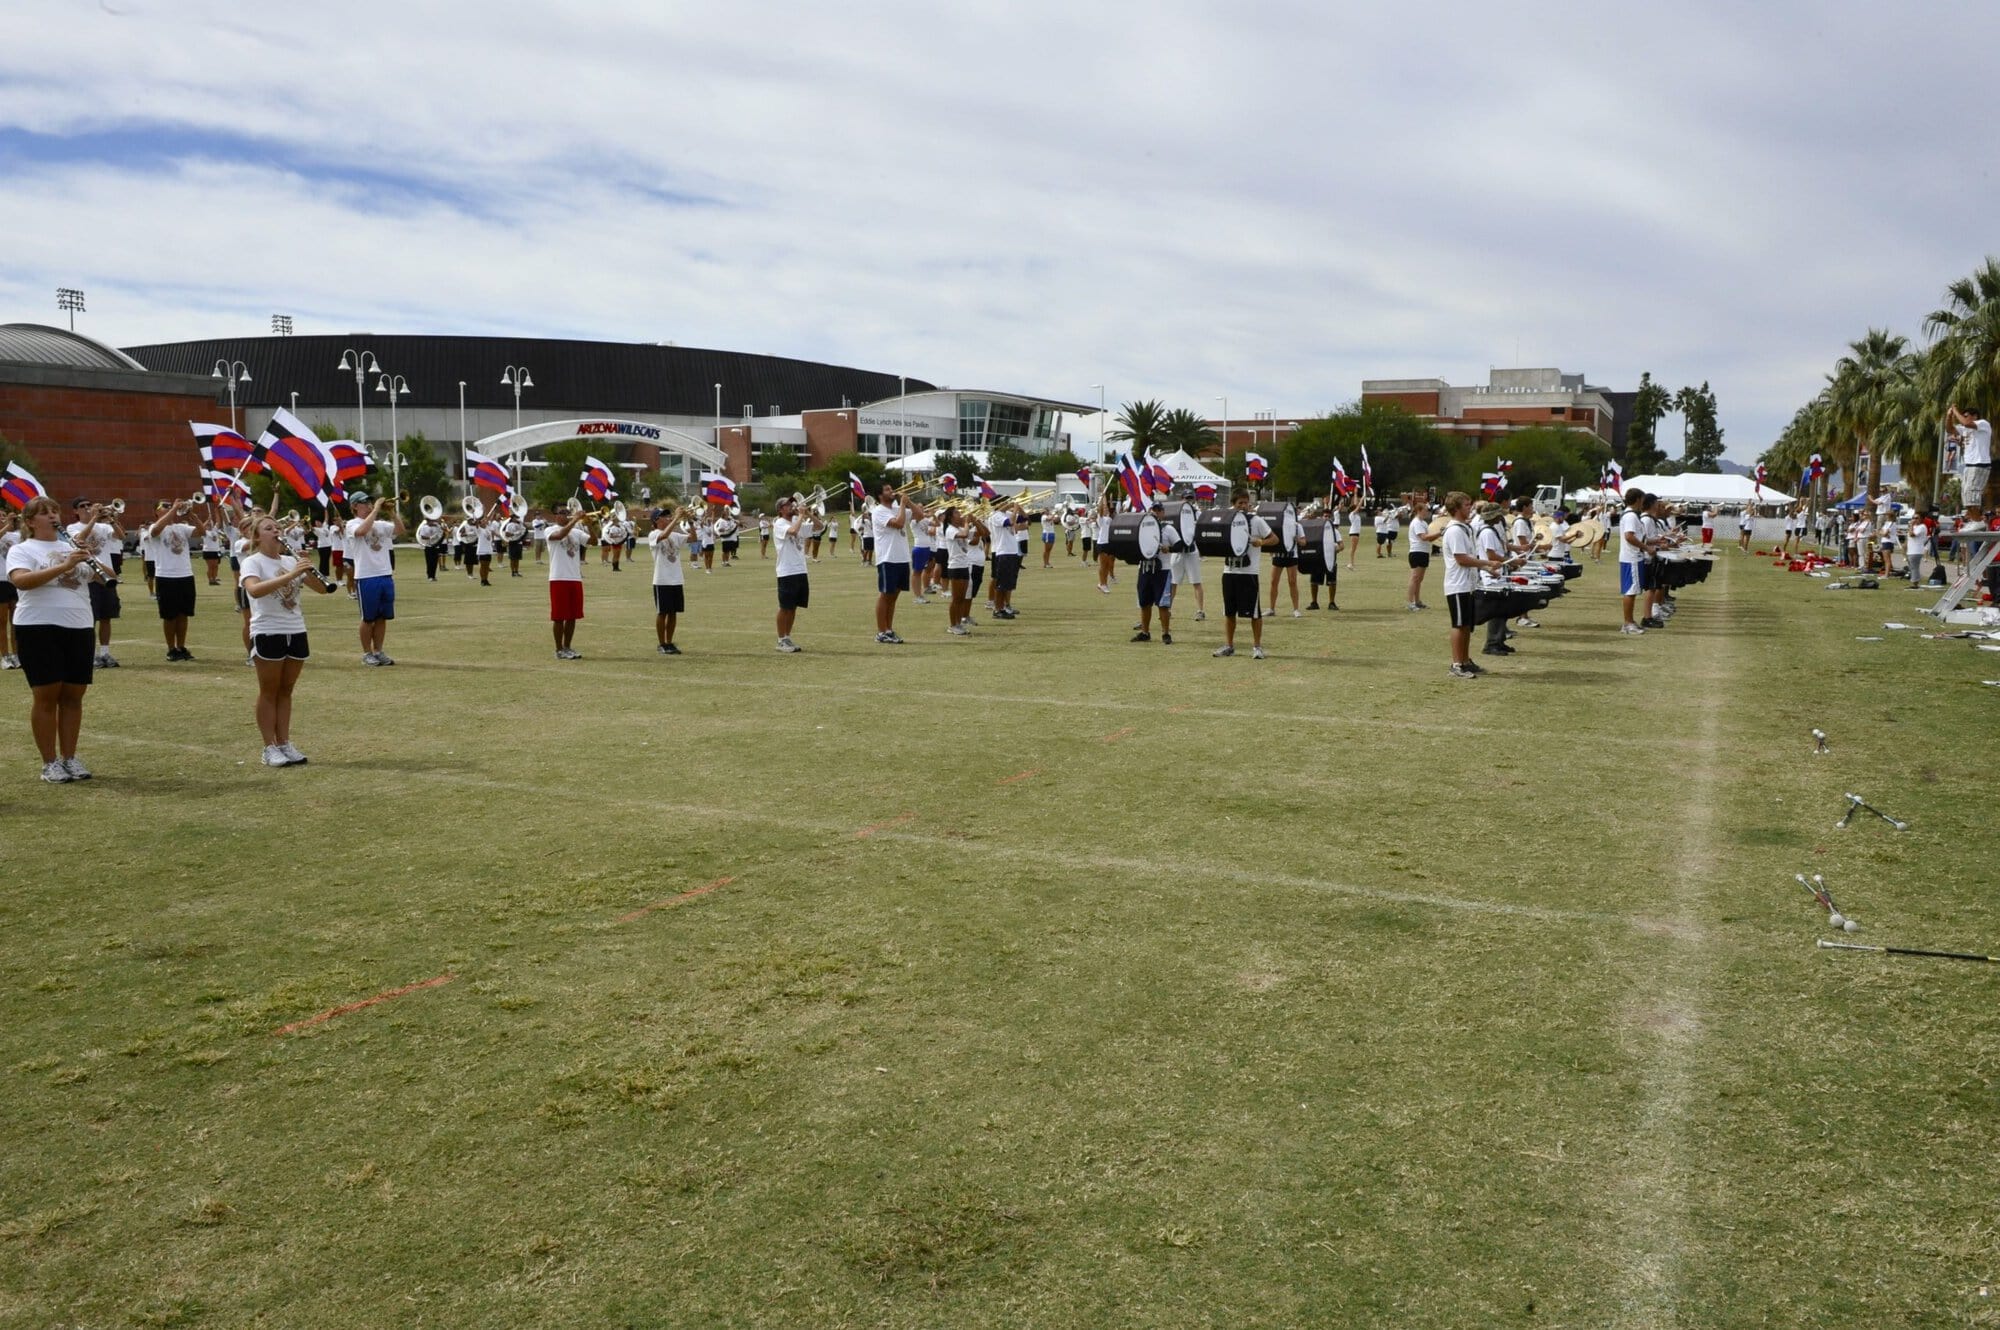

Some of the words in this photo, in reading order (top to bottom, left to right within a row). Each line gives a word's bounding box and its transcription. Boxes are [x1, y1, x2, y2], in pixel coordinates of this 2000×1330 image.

[860, 417, 875, 425] Eddie
[877, 418, 892, 427] Lynch
[912, 420, 930, 429] Pavilion
